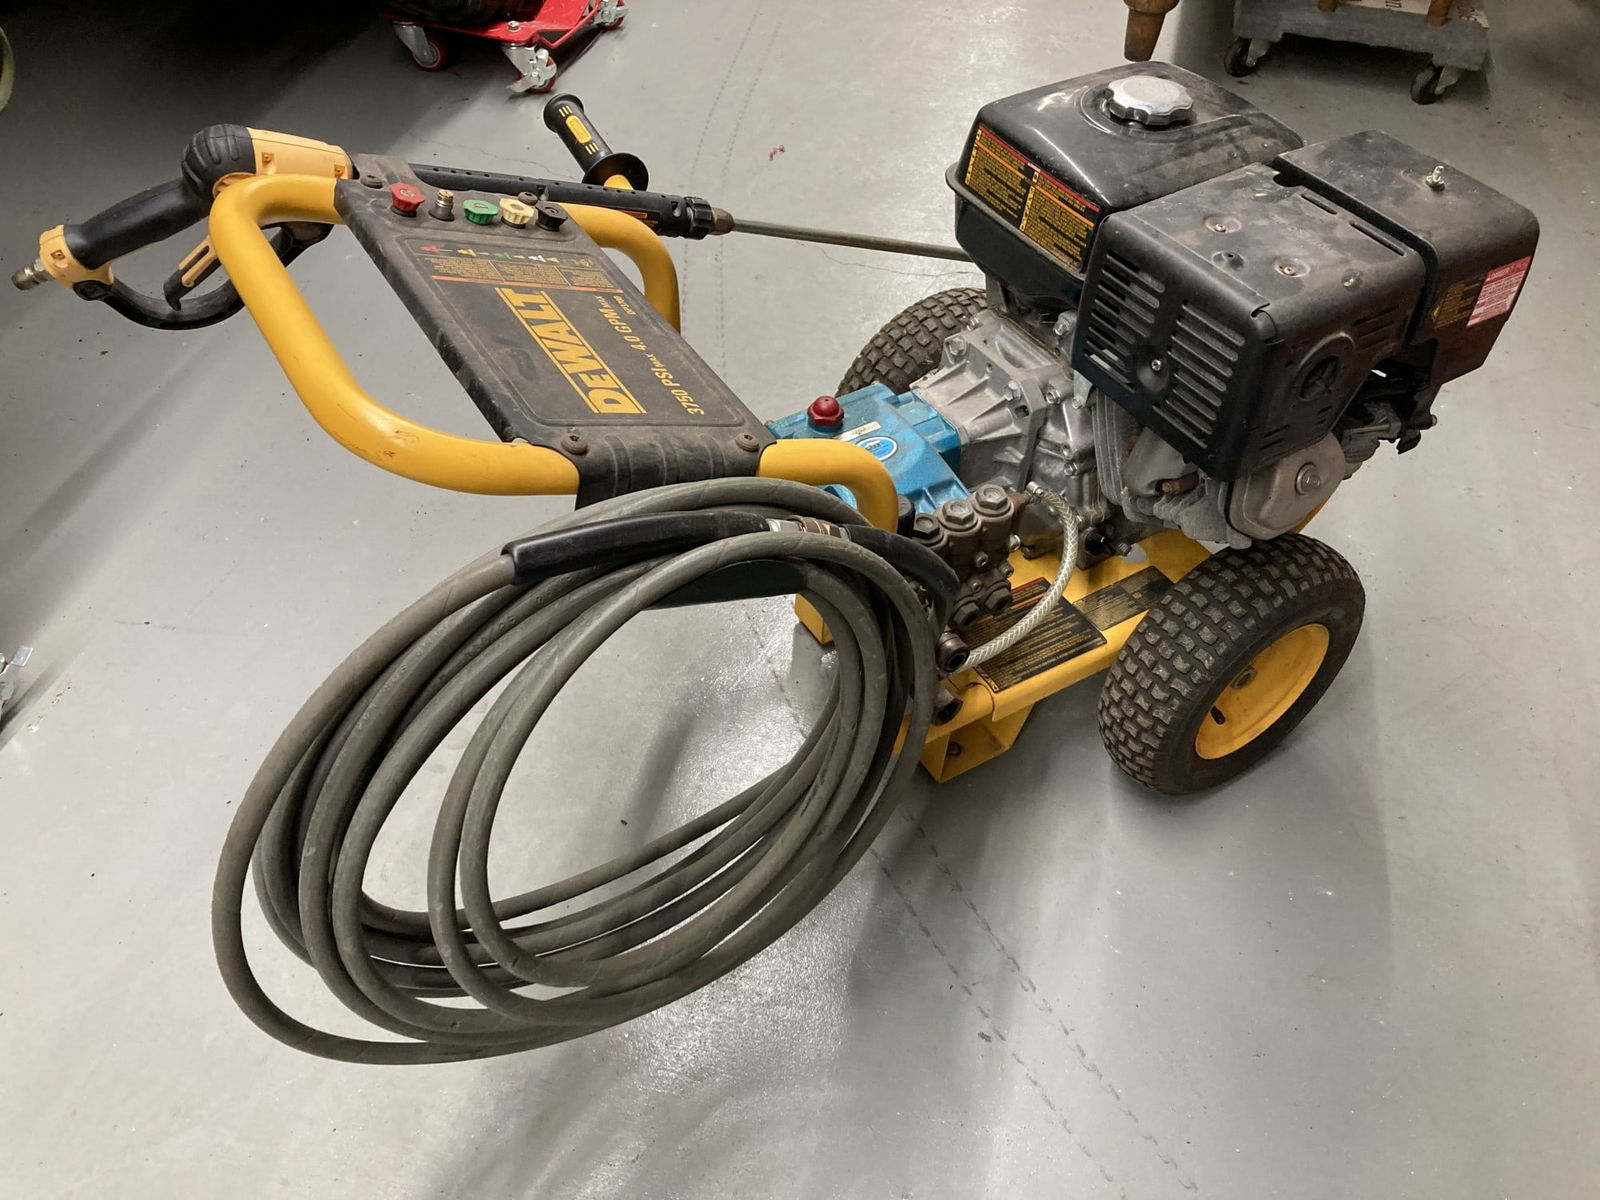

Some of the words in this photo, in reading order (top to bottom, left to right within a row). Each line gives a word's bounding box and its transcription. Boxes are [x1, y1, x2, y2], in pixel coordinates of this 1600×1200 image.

[598, 308, 632, 333] GPM
[498, 287, 643, 414] DEWALT
[623, 335, 647, 350] 4.0
[650, 367, 681, 387] PSI
[671, 389, 705, 415] 3750
